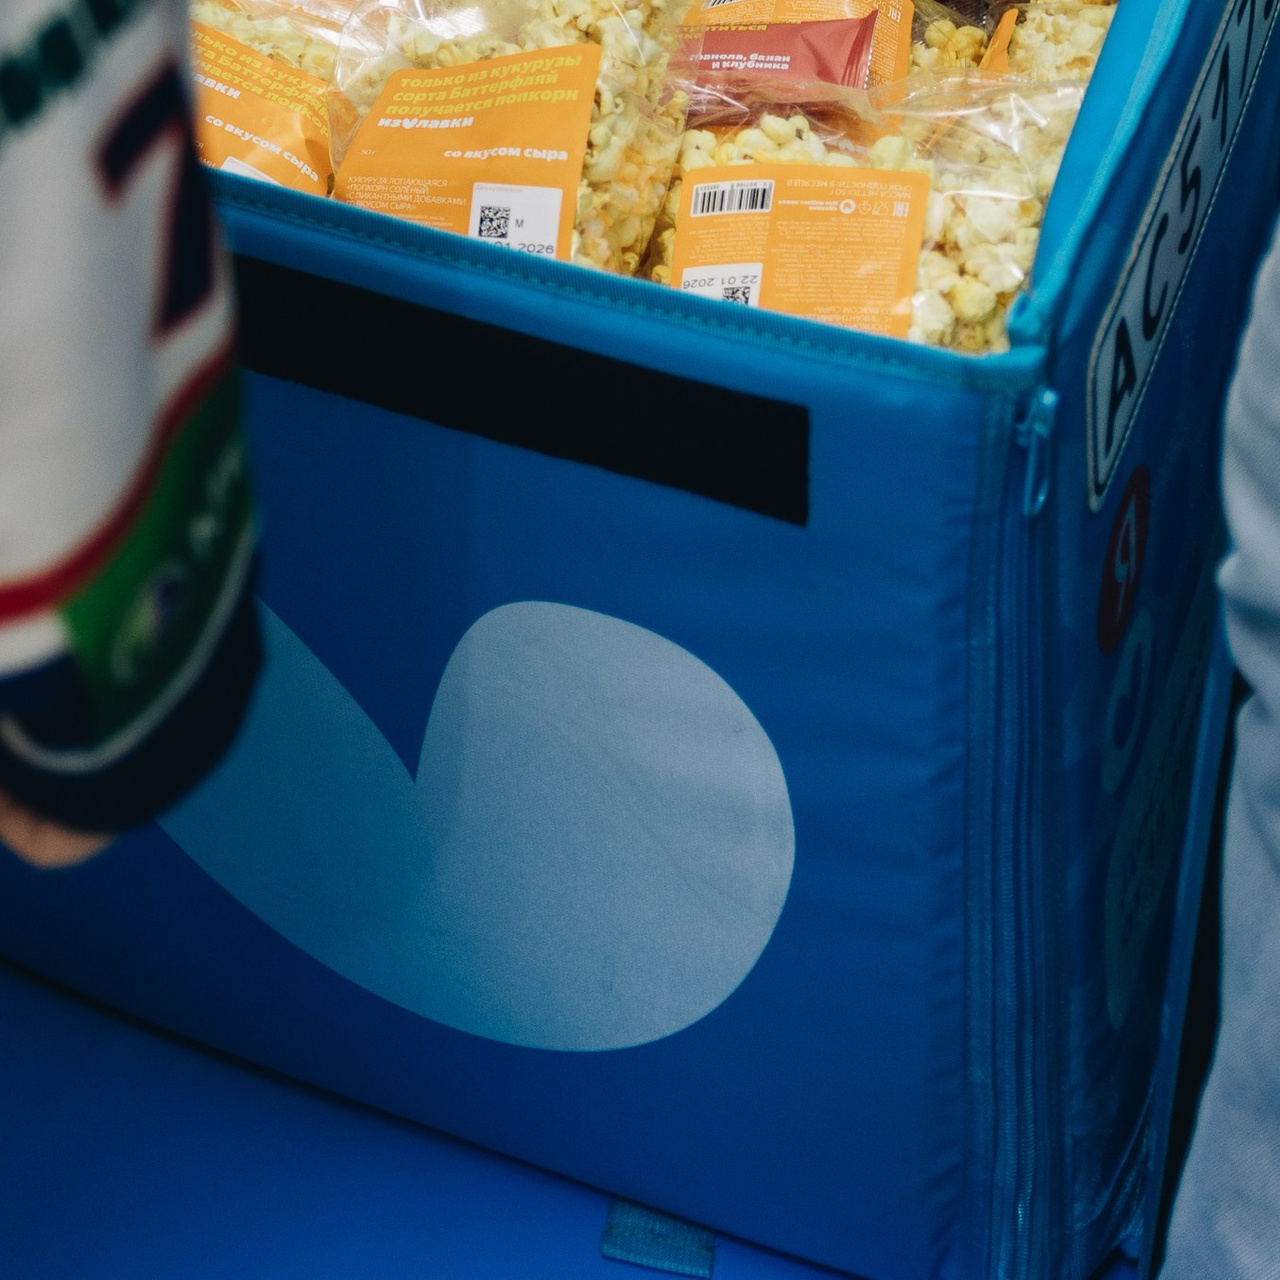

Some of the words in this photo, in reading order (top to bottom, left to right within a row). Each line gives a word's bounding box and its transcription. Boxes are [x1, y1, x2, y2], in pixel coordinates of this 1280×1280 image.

[401, 73, 465, 88] только
[468, 69, 488, 83] из
[490, 55, 581, 79] кукурузы
[711, 61, 721, 70] и
[722, 60, 789, 70] клубника
[749, 52, 791, 63] банан
[193, 73, 241, 100] авки
[392, 90, 447, 104] сорта
[449, 70, 560, 100] Баттерфляй
[385, 97, 492, 118] получается
[494, 88, 579, 107] попкорн
[205, 114, 224, 127] со
[224, 122, 283, 156] вкусом
[282, 150, 319, 183] сыра
[444, 149, 462, 158] со
[463, 147, 520, 161] вкусом
[523, 148, 569, 162] сыра
